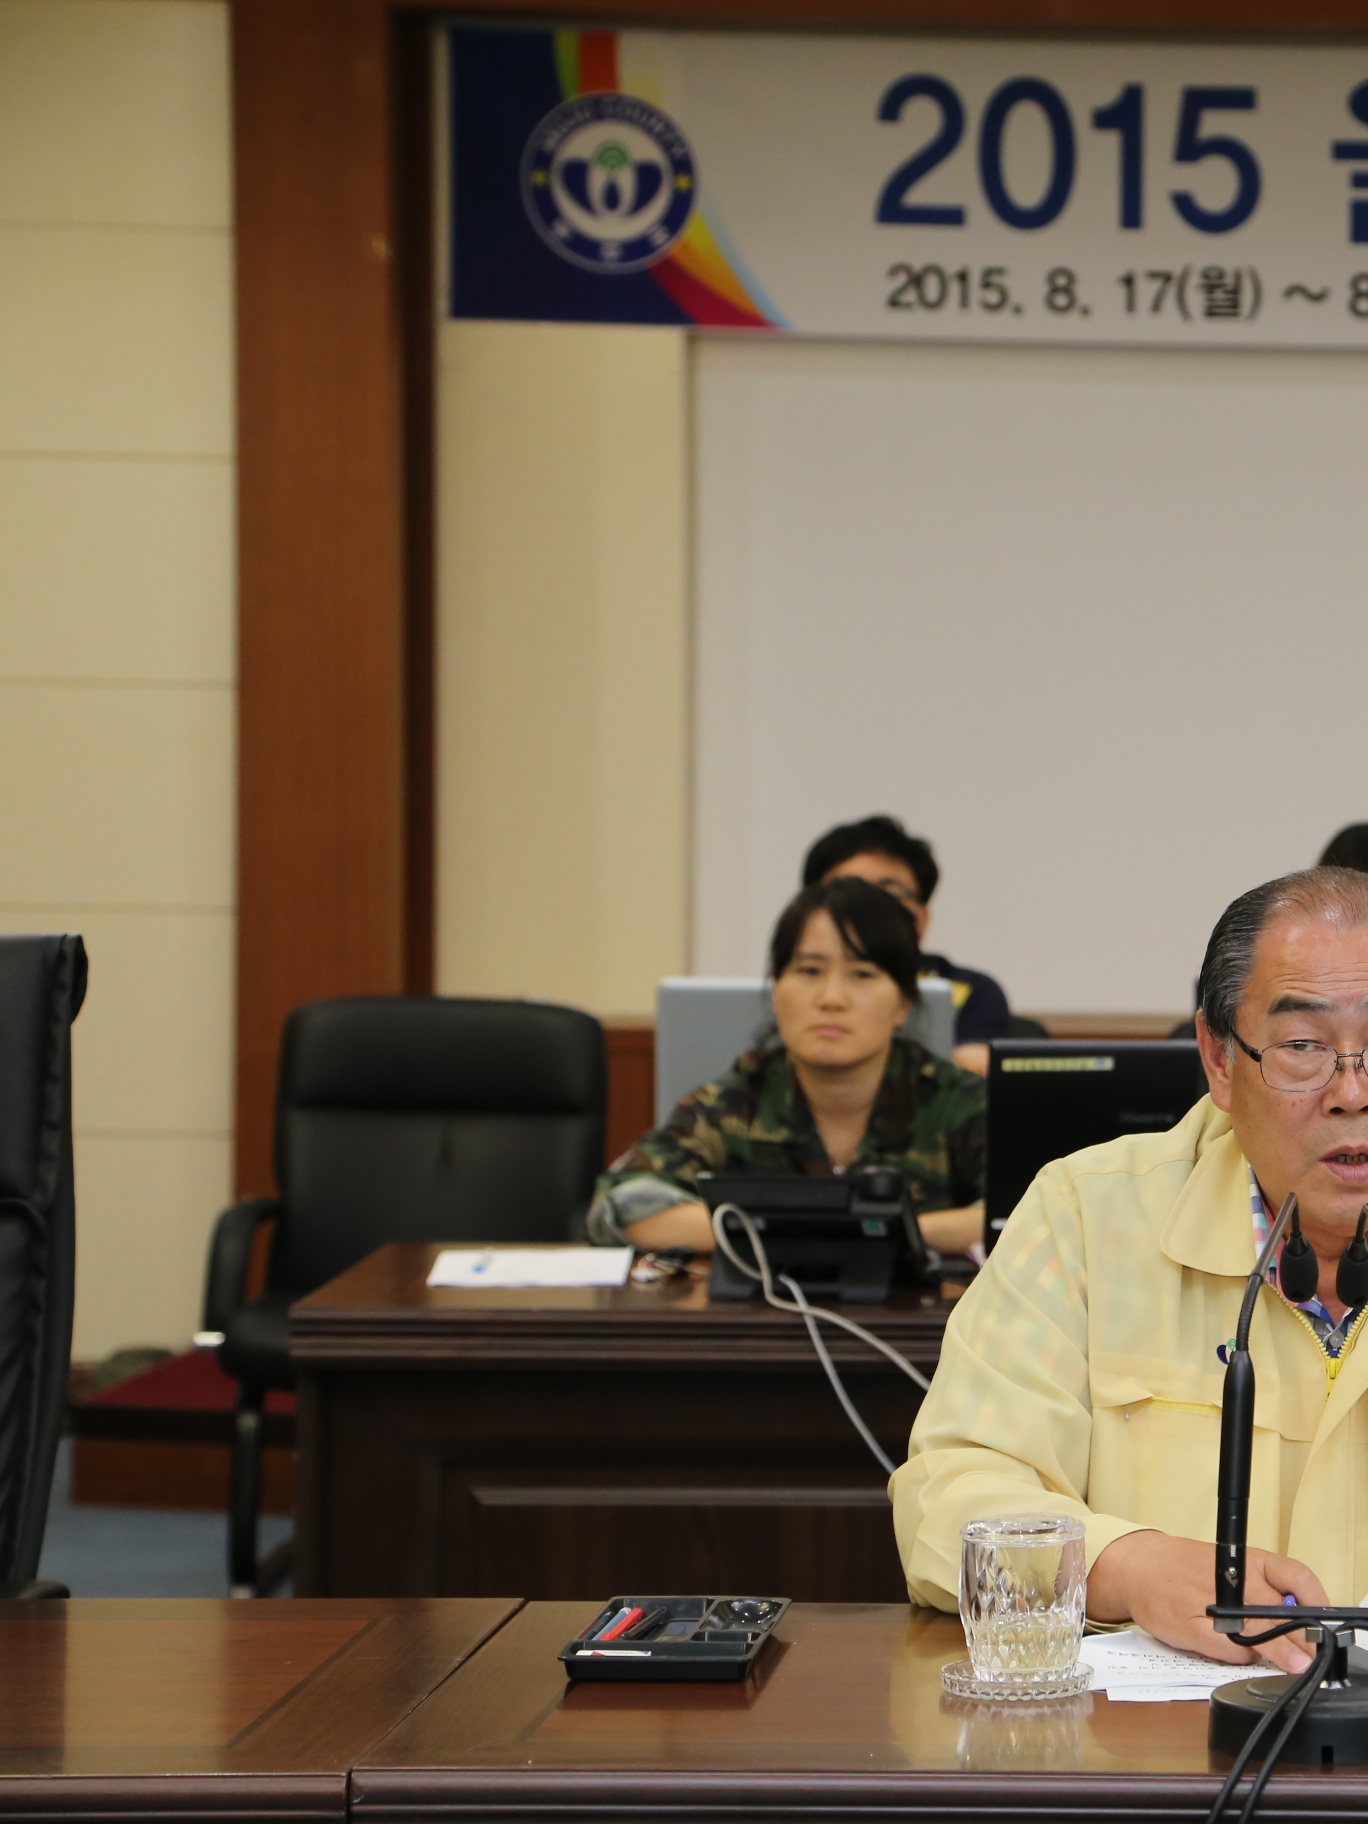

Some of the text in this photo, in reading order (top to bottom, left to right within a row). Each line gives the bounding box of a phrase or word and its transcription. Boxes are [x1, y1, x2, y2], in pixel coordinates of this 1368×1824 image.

[874, 70, 1264, 235] 2015
[885, 261, 1024, 315] 2015.
[1043, 265, 1092, 317] 8.
[1117, 264, 1264, 322] 17(월)
